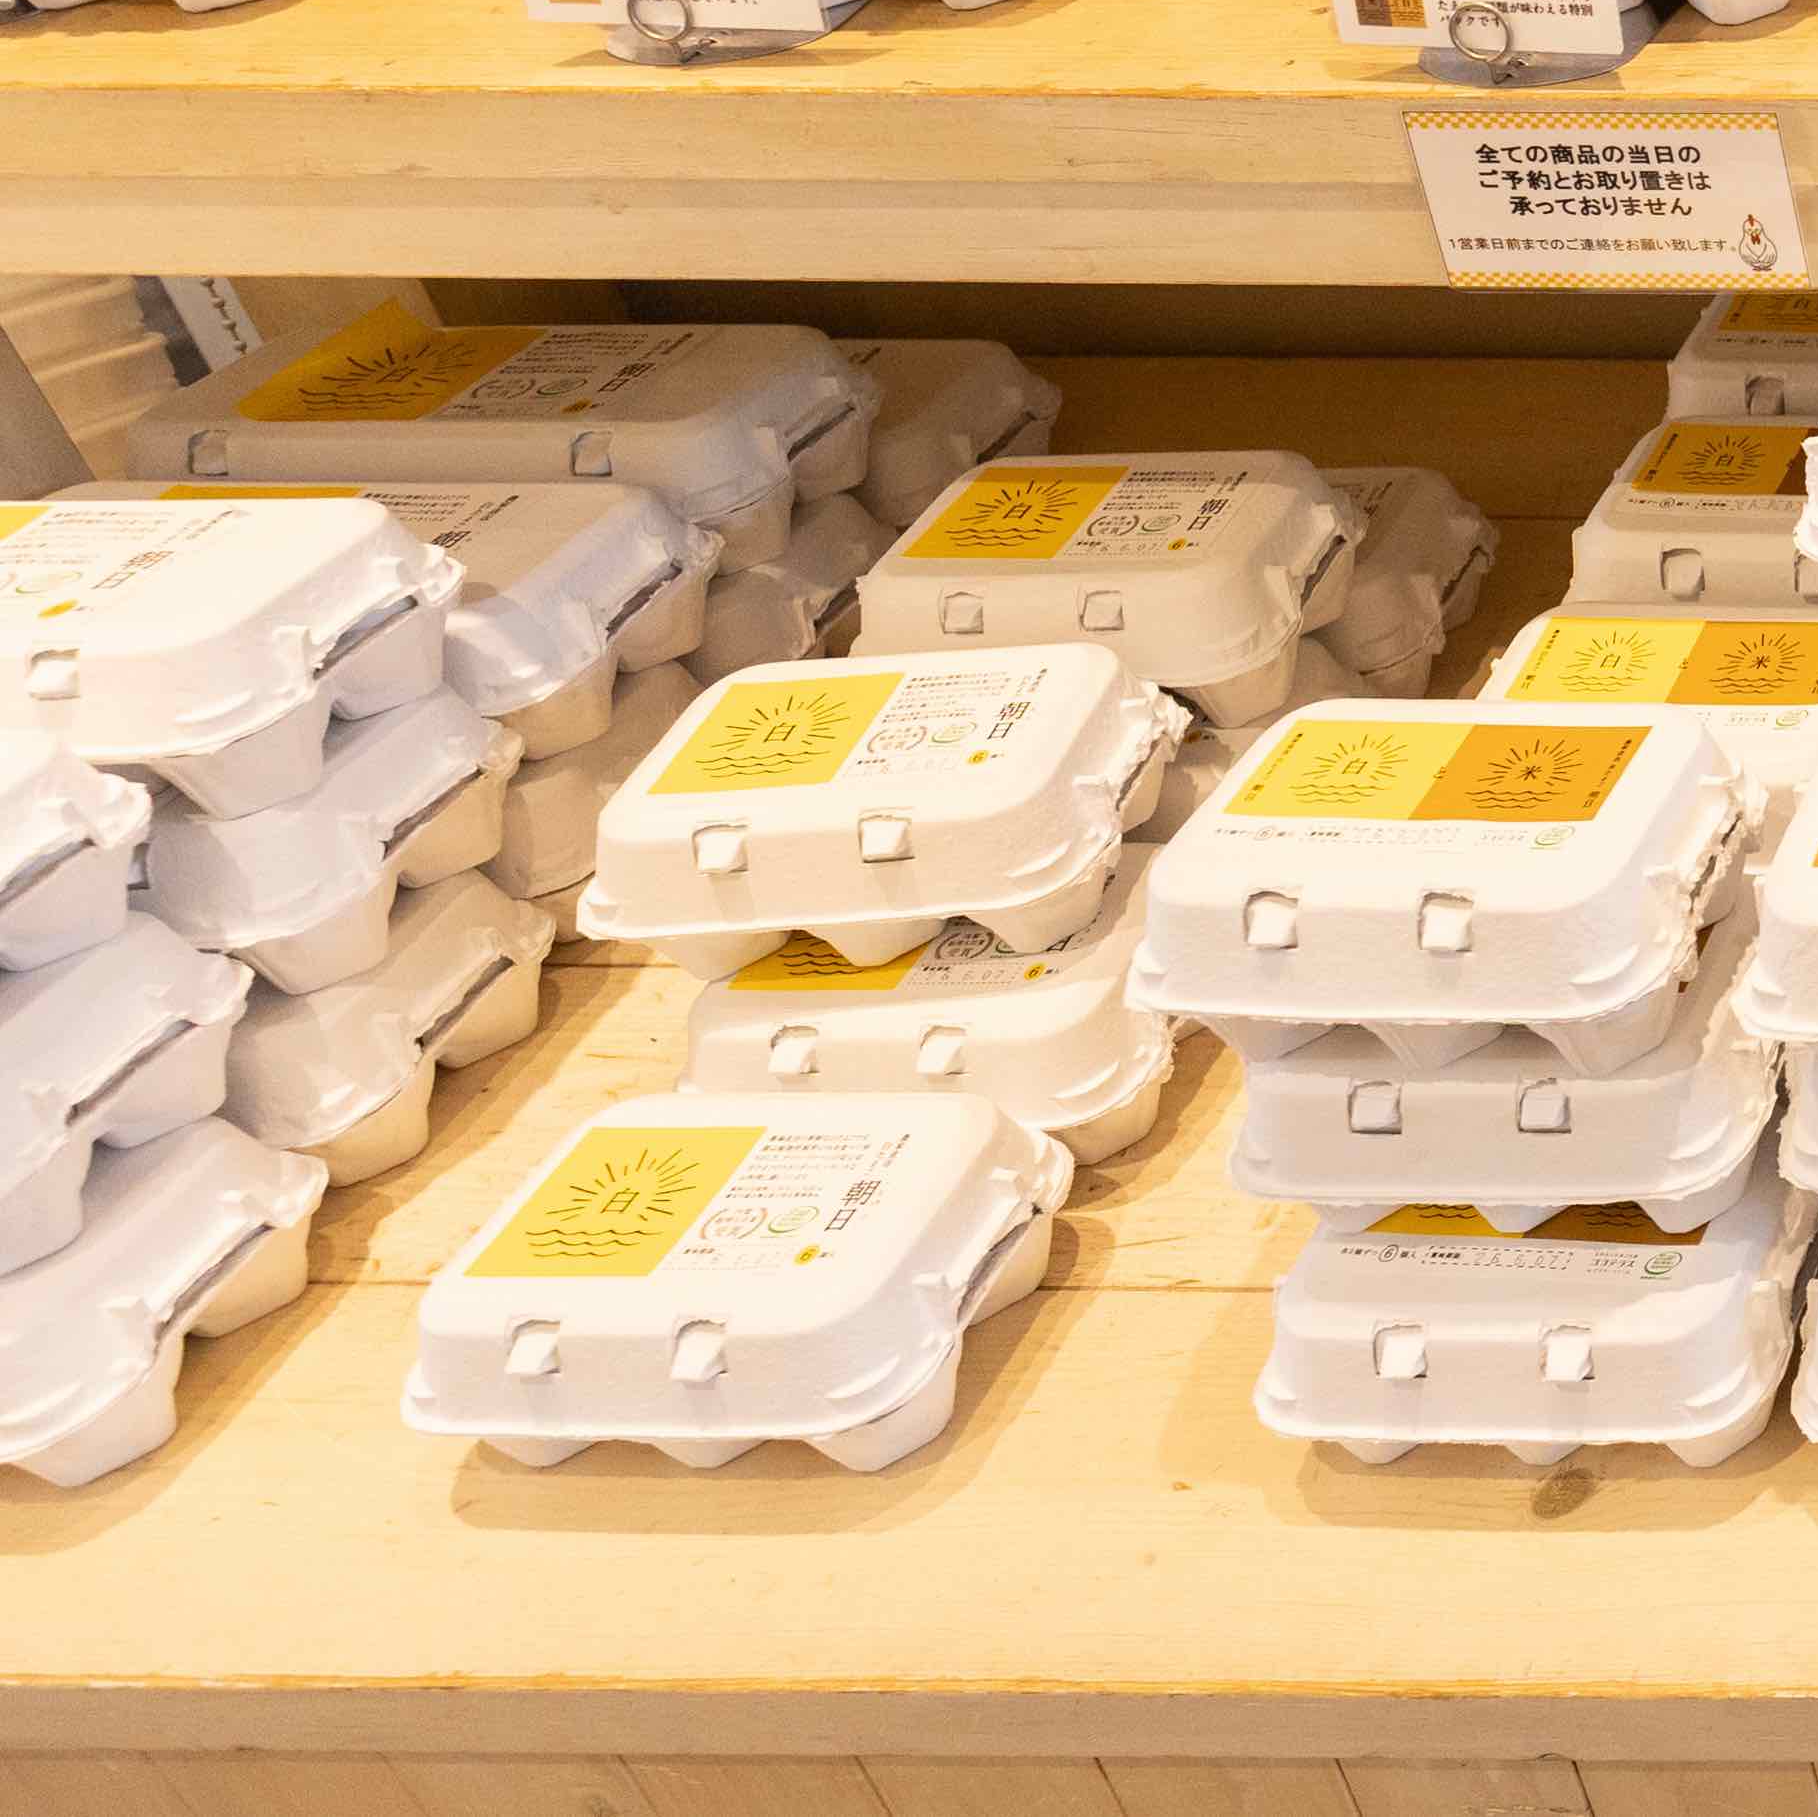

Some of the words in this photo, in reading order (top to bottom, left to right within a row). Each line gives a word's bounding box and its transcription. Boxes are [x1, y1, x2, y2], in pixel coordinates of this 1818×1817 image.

[1475, 143, 1702, 166] 全ての商品の当日の
[1477, 169, 1713, 193] ご予約とお取り置きは
[1509, 195, 1694, 218] 承っておりません
[1004, 500, 1030, 520] 白
[1186, 497, 1230, 532] 朝日
[987, 699, 1033, 741] 朝日
[760, 721, 797, 746] 白
[1340, 758, 1369, 777] 白
[1516, 764, 1543, 783] 米
[600, 1186, 636, 1215] 白
[824, 1177, 883, 1234] 朝日
